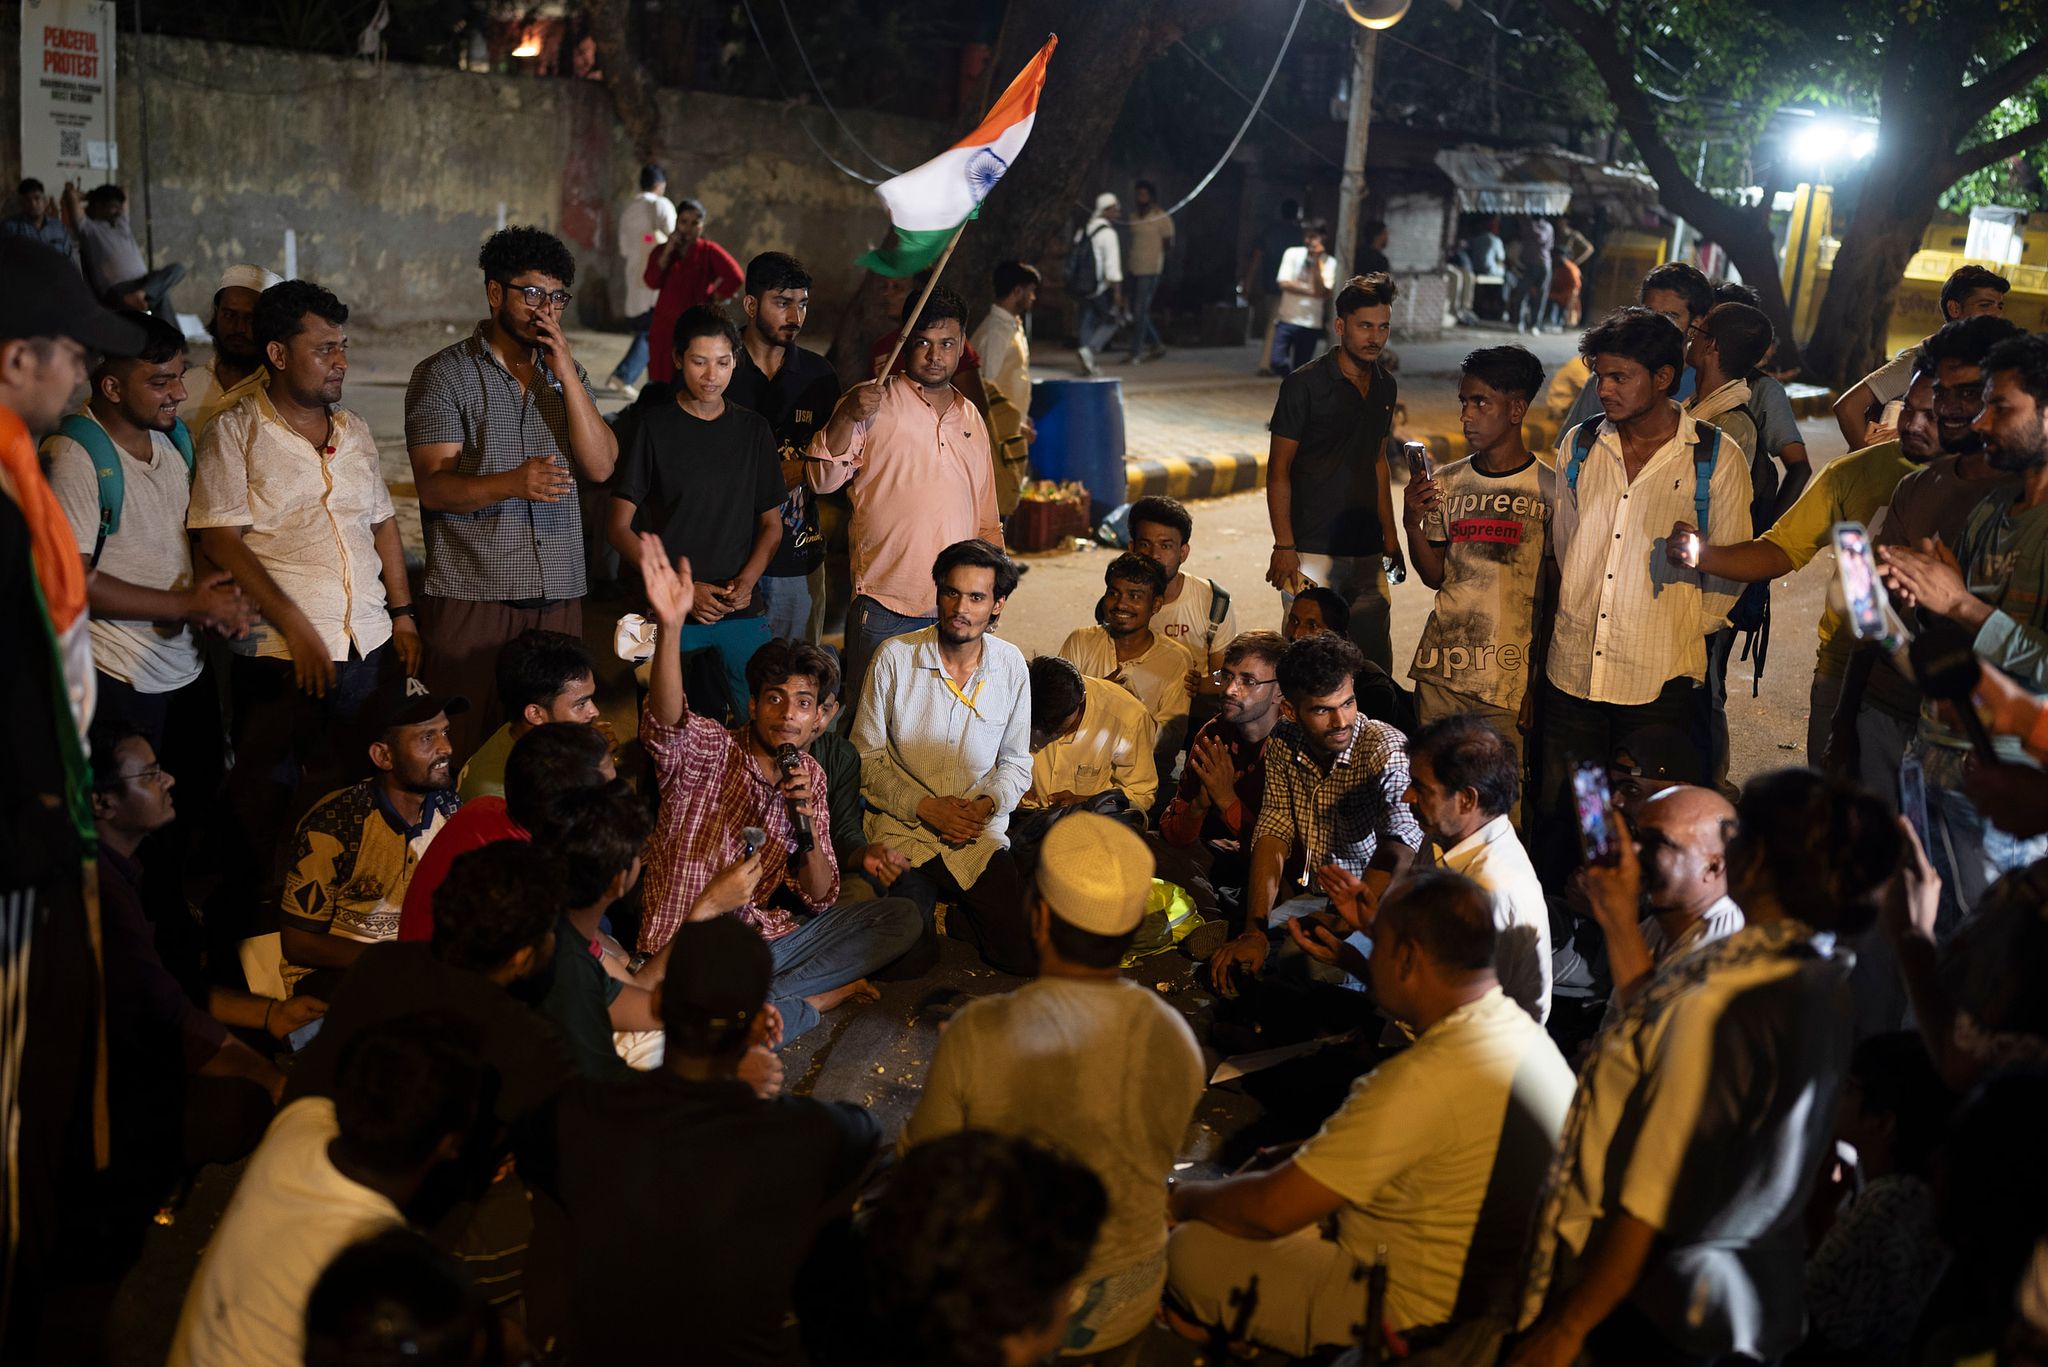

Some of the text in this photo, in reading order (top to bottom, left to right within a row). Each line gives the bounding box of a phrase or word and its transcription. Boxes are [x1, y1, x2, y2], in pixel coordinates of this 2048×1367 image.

[44, 26, 98, 53] PEACEFUL
[43, 51, 99, 78] PROTEST
[1451, 523, 1518, 539] Supreem
[1164, 624, 1190, 637] CJP
